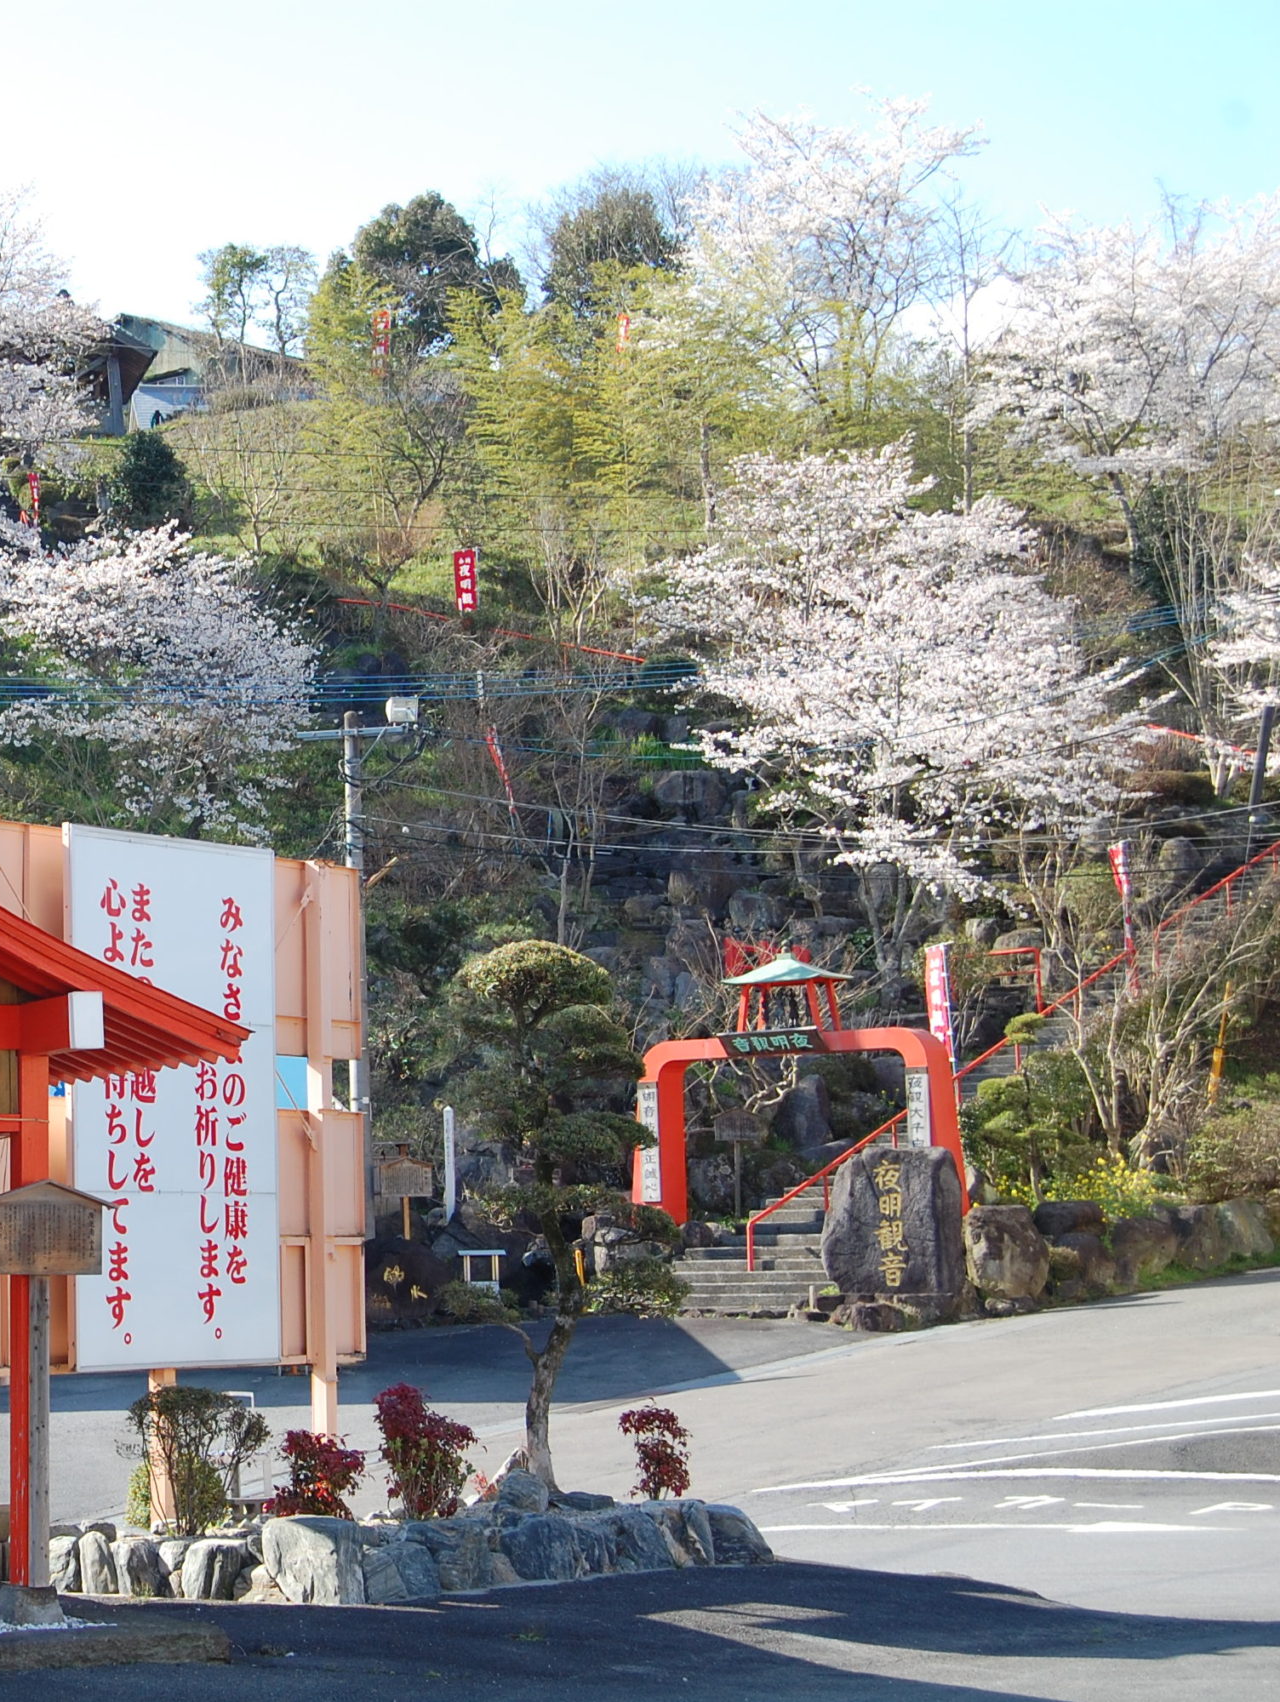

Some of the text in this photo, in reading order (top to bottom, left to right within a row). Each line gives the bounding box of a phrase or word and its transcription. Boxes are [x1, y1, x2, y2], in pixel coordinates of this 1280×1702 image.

[130, 883, 157, 1194] また越しを
[220, 896, 248, 1286] みなさのご健康を
[872, 1159, 909, 1287] 夜明観音
